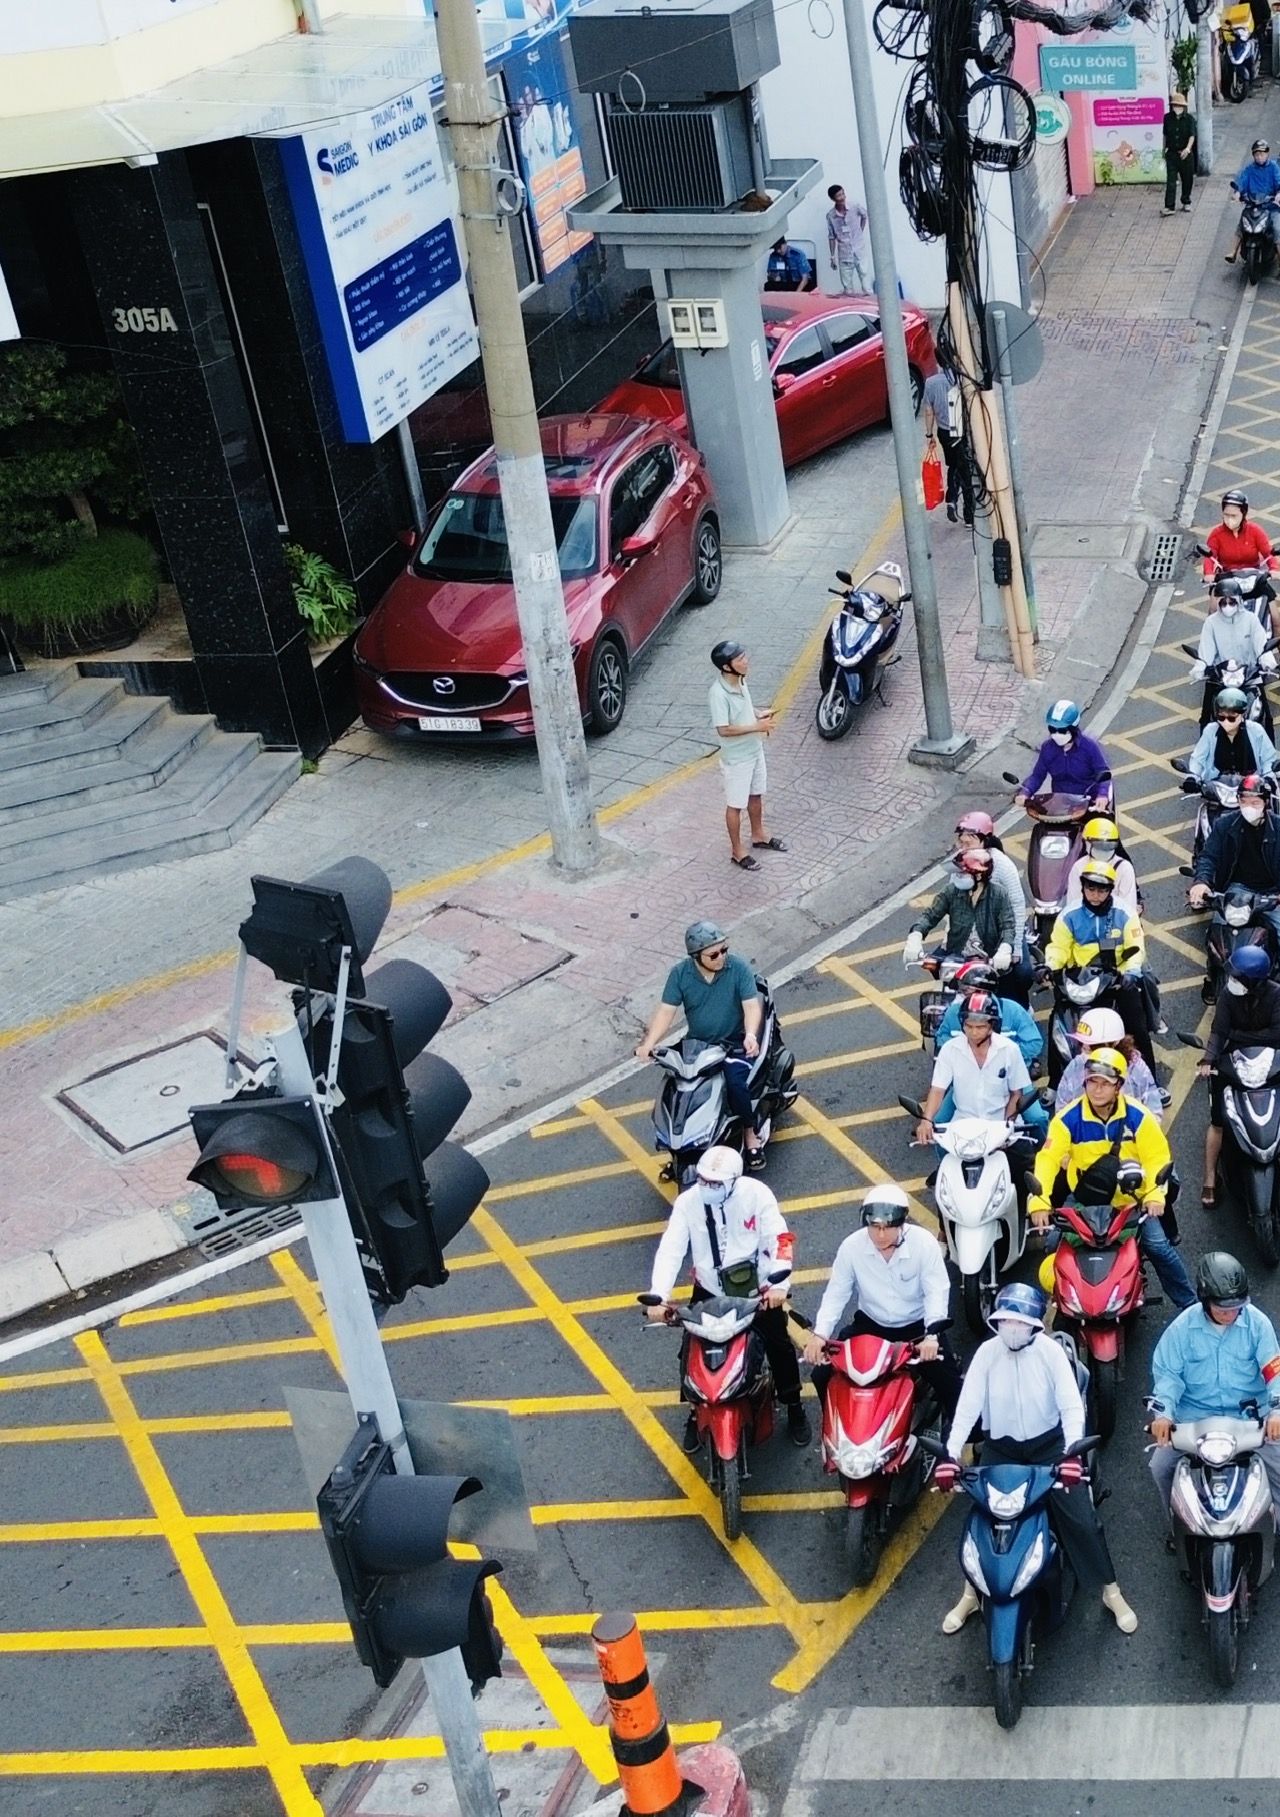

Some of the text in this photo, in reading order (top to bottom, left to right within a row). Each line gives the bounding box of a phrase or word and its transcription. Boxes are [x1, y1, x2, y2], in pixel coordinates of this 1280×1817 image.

[1062, 74, 1115, 85] ONLINE
[371, 95, 414, 130] TRUNG TÂM
[368, 112, 428, 156] Y KHOA SÀI GÒN
[330, 140, 352, 160] SAIGON
[334, 152, 360, 178] MEDIC
[111, 306, 178, 333] 305A
